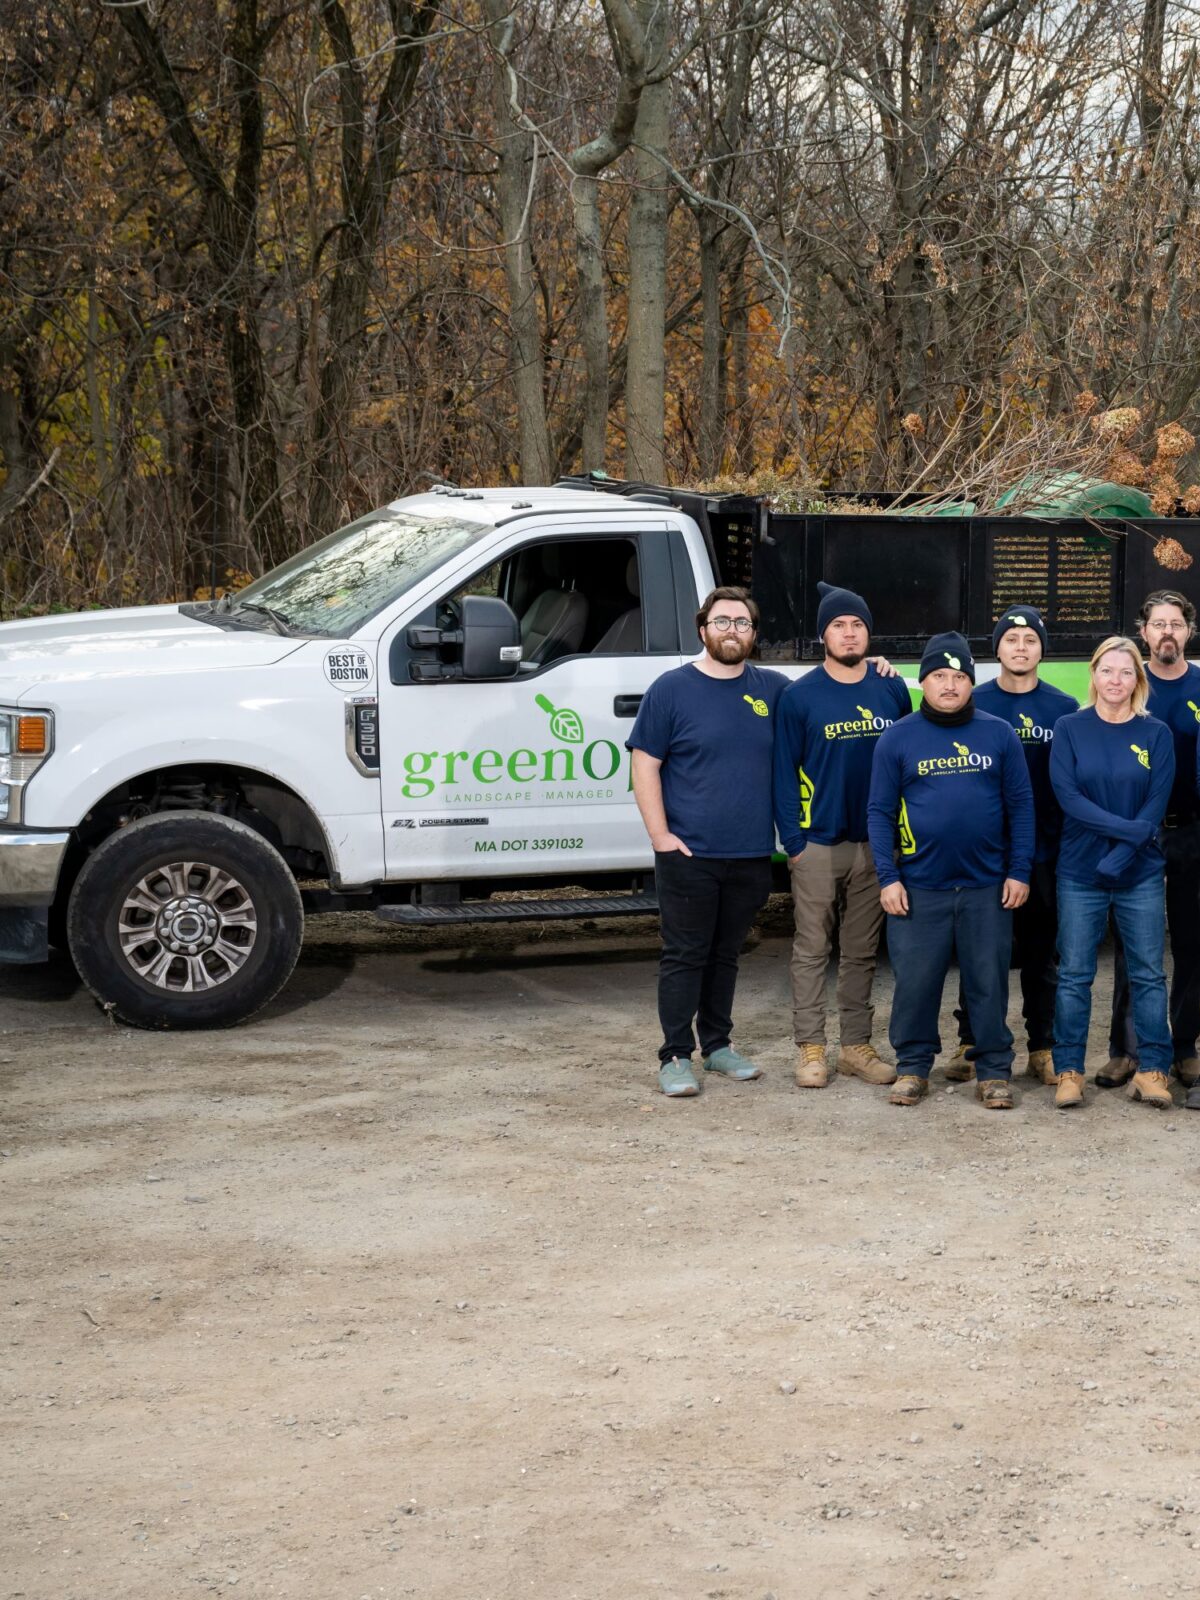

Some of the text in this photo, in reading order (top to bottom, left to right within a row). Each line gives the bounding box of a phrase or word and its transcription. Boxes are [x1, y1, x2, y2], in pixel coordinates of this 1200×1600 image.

[328, 654, 366, 667] BEST OF
[330, 668, 369, 680] BOSTON
[917, 753, 993, 776] greenOp
[421, 819, 451, 827] POWER
[474, 838, 584, 852] MA DOT 3391032
